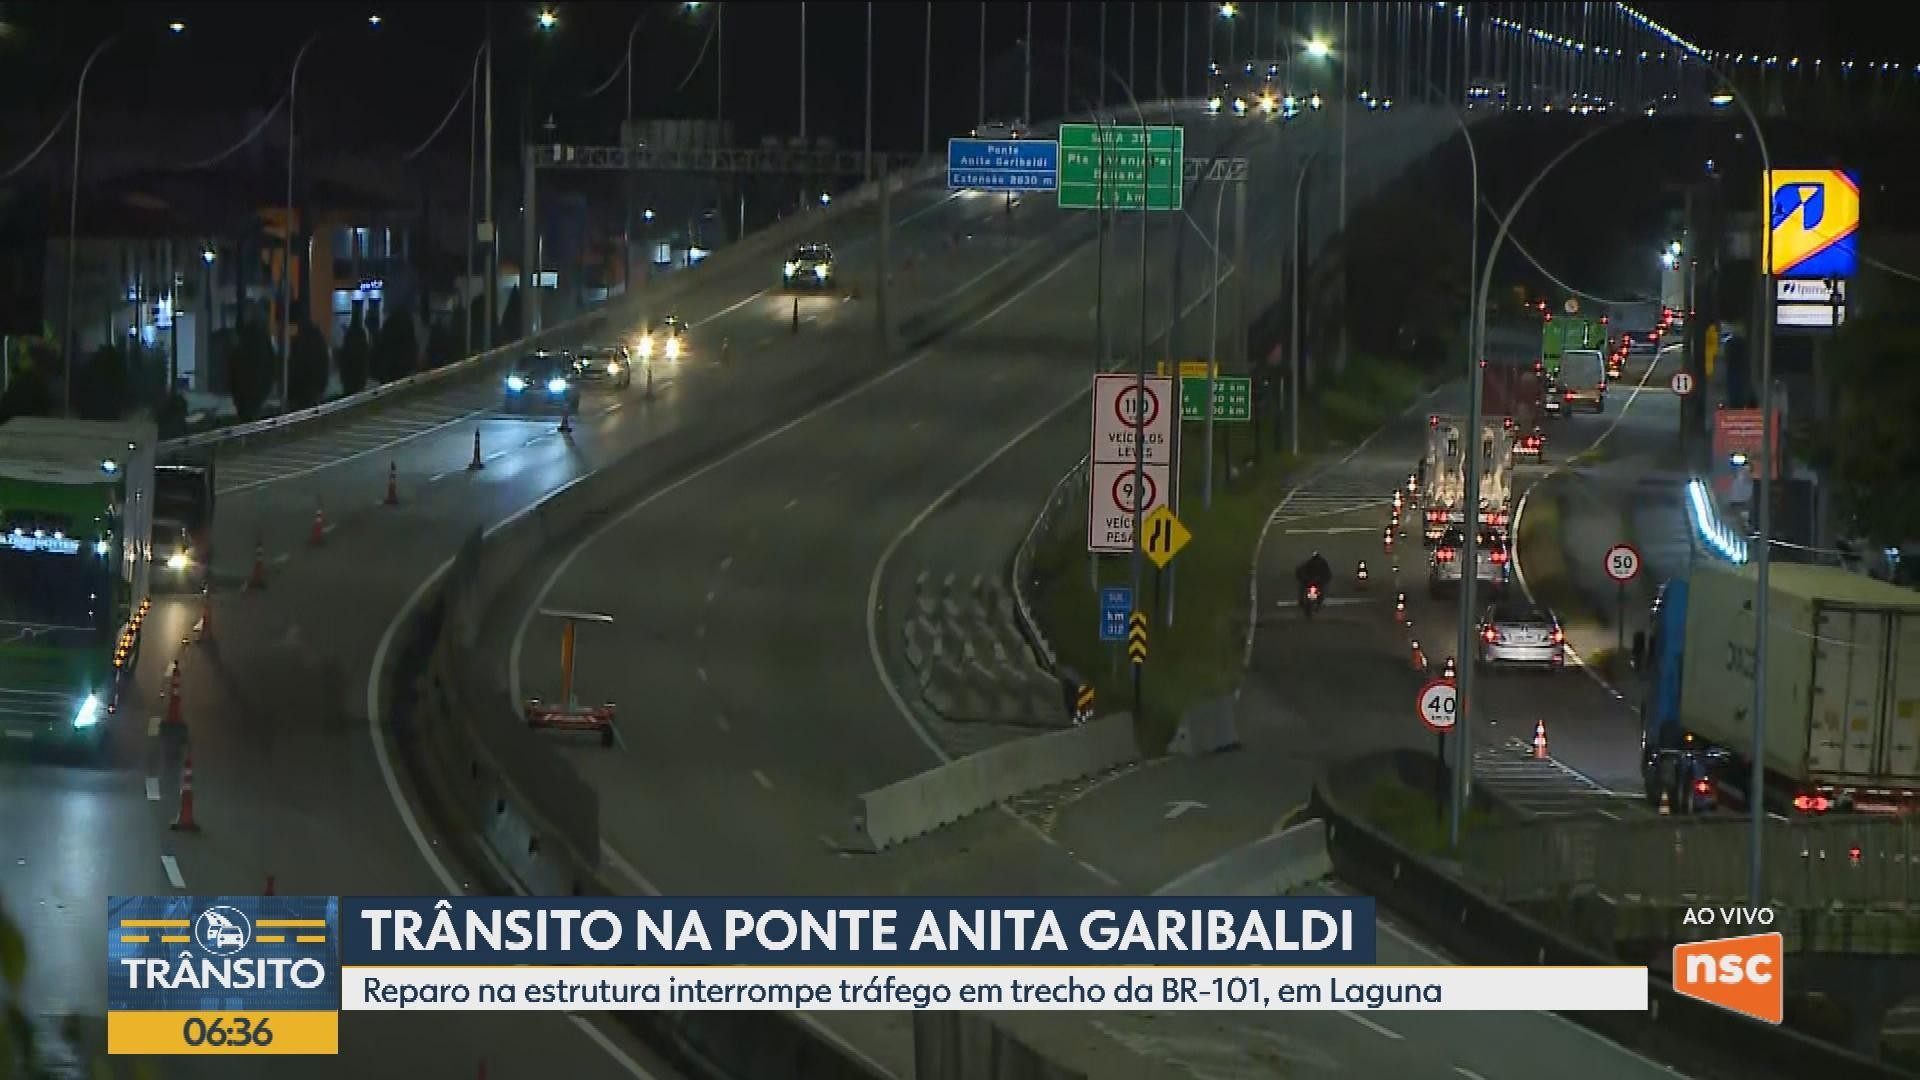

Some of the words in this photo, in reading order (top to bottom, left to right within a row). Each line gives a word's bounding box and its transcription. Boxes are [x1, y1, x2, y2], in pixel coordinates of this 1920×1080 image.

[987, 144, 1019, 155] Ponte
[960, 156, 991, 166] Anita
[996, 157, 1048, 168] Garibaldi
[953, 173, 1004, 184] Extensão
[1043, 177, 1052, 185] m
[1108, 432, 1164, 445] VEÍCOS
[1118, 446, 1153, 459] LEVS
[1122, 483, 1146, 499] 9
[1613, 555, 1633, 569] 50
[1107, 610, 1124, 621] km
[1427, 695, 1456, 714] 40
